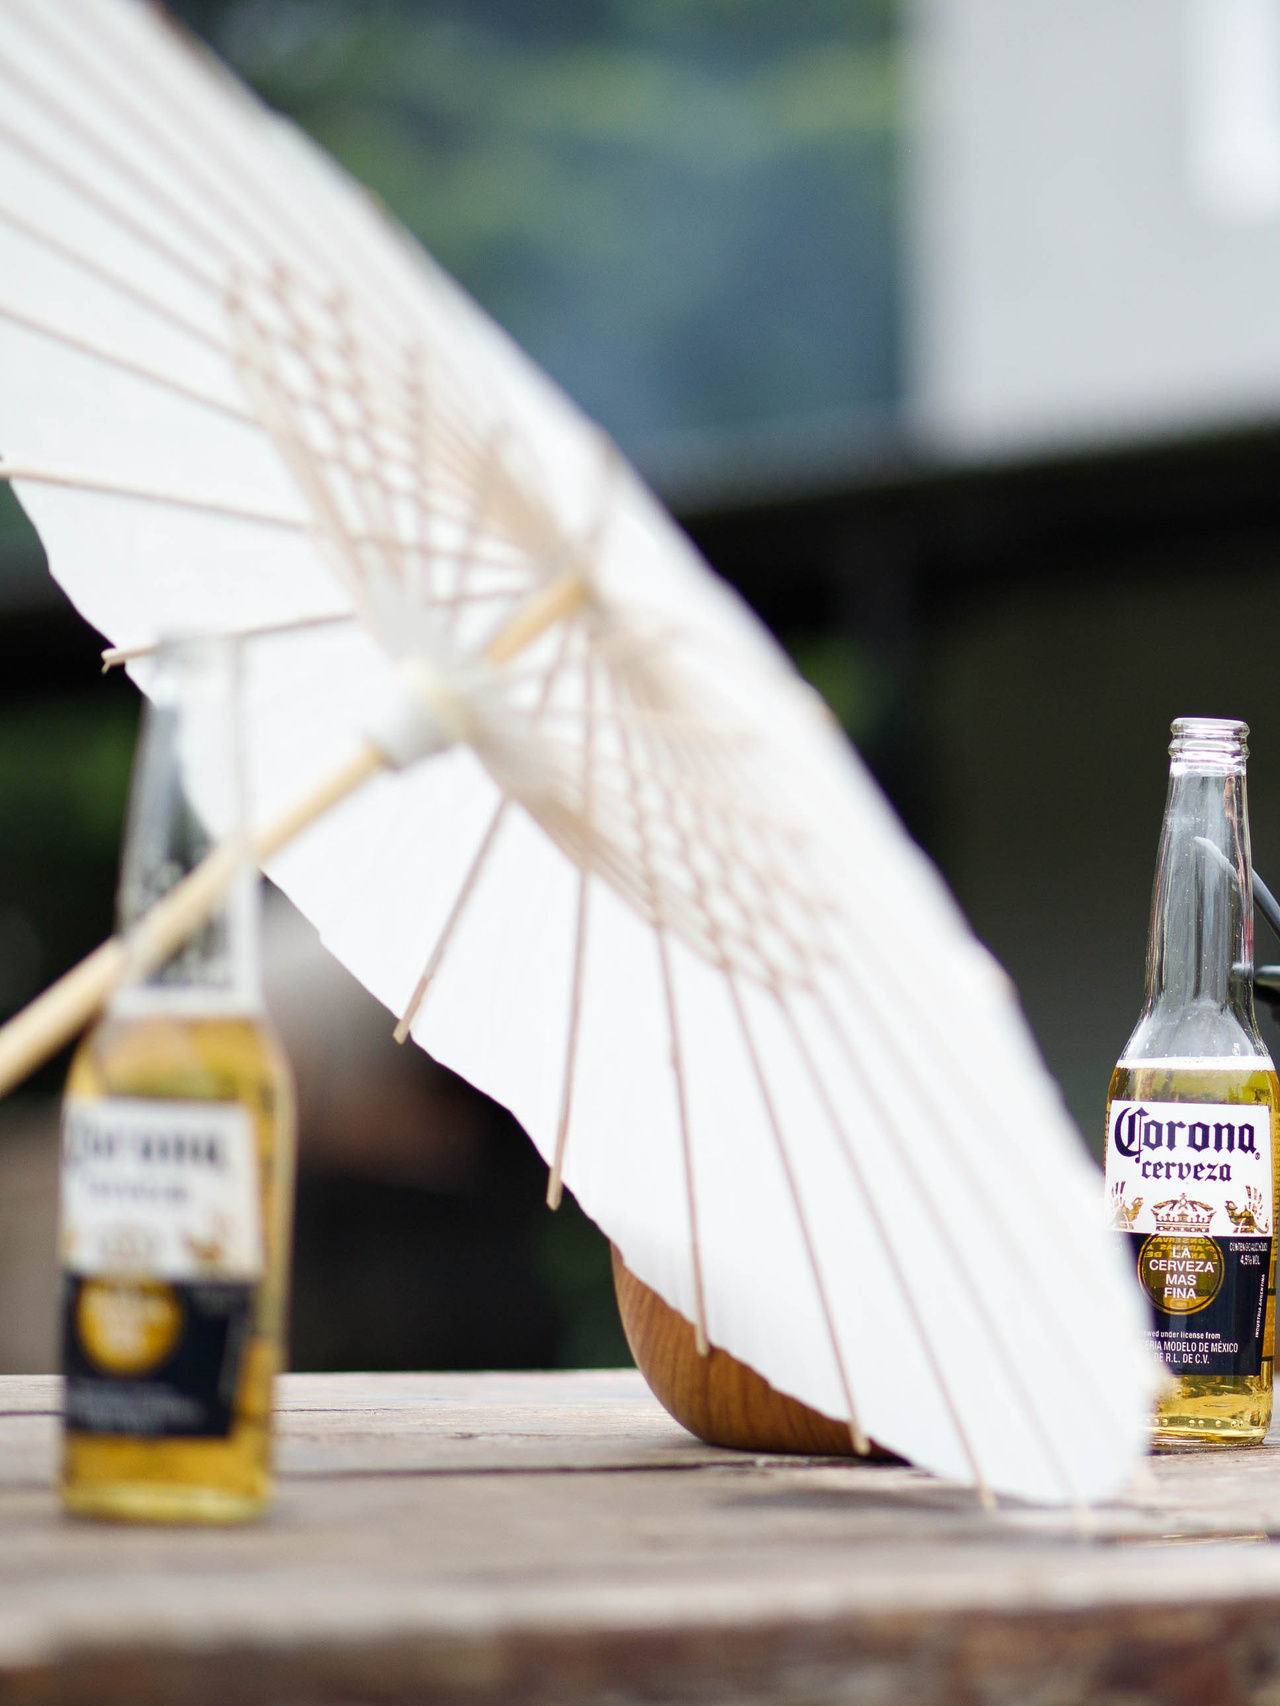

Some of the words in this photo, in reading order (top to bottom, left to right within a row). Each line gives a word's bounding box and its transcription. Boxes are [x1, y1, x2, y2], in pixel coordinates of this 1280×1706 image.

[1114, 1107, 1256, 1163] Corona
[1141, 1160, 1232, 1182] cerveza
[1172, 1246, 1191, 1258] LA
[1149, 1259, 1214, 1273] CERVEZA
[1165, 1274, 1197, 1286] MAS
[1164, 1287, 1197, 1300] FINA
[1160, 1330, 1179, 1338] under
[1180, 1330, 1205, 1340] license
[1205, 1331, 1221, 1340] from
[1163, 1341, 1197, 1352] MODELO
[1198, 1342, 1209, 1353] DE
[1210, 1340, 1239, 1353] MÉXICO
[1165, 1353, 1181, 1363] R.L.
[1182, 1353, 1193, 1363] DE
[1195, 1353, 1210, 1364] C.V.
